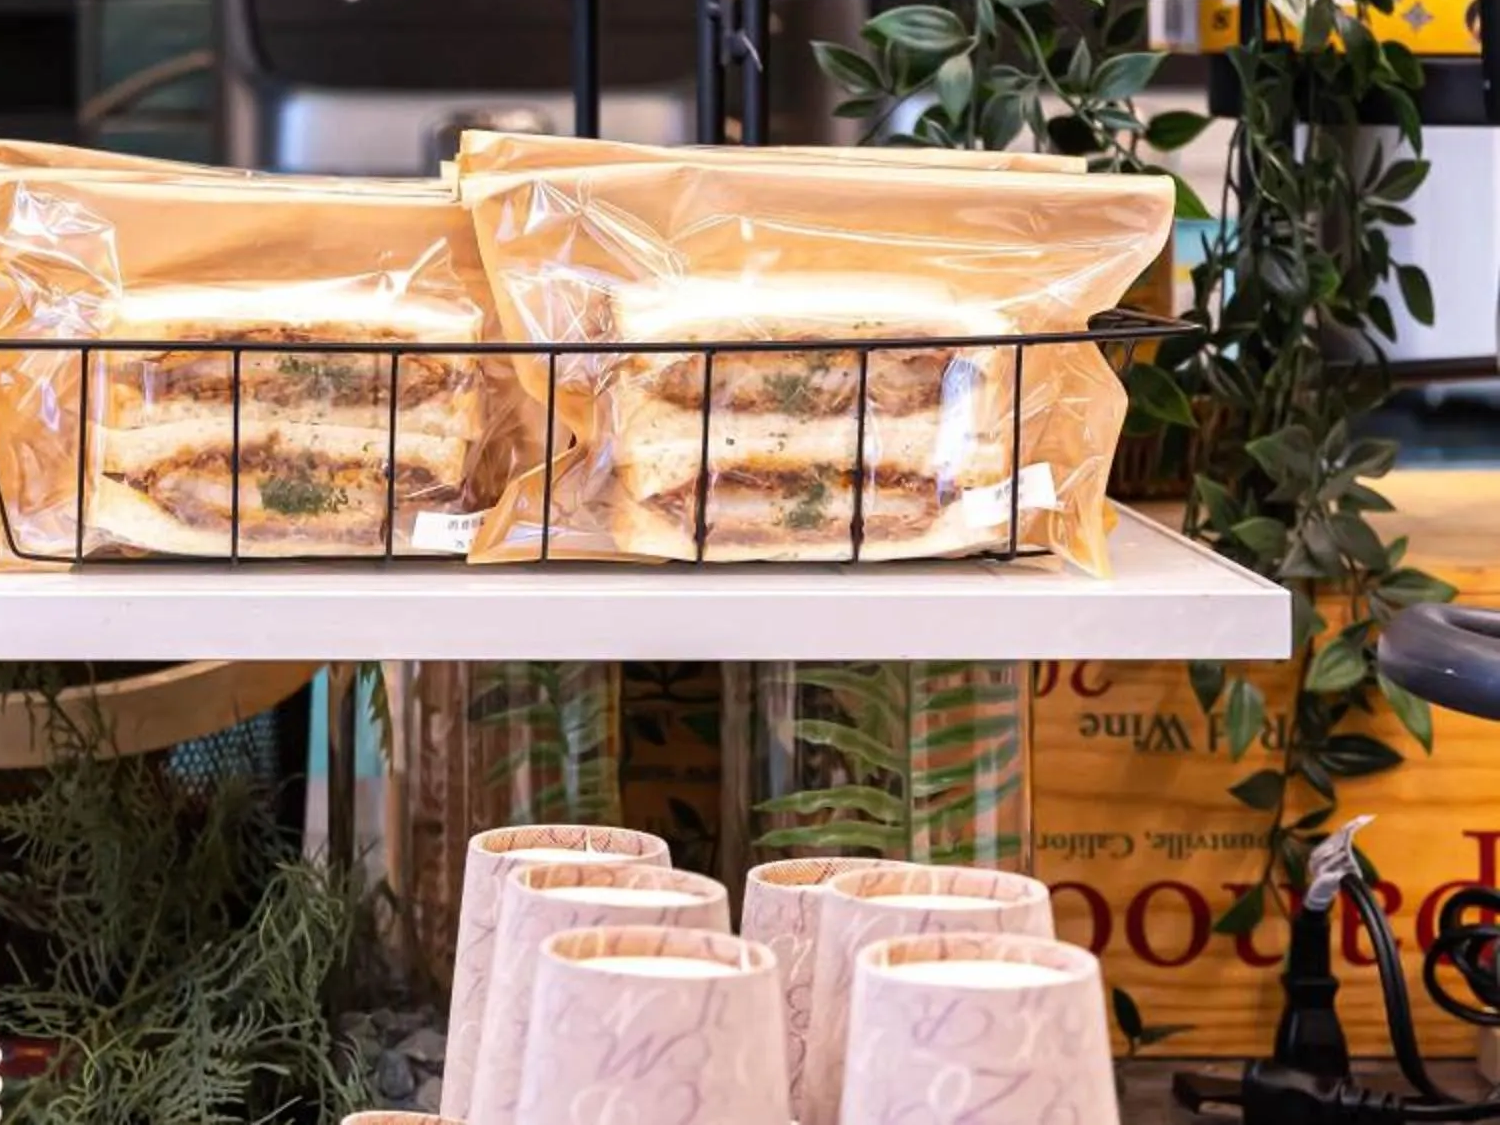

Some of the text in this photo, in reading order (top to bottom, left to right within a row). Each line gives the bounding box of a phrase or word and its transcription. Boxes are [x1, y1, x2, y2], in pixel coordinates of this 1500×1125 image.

[1079, 712, 1287, 752] Rd Wine
[1144, 832, 1268, 860] ountville,
